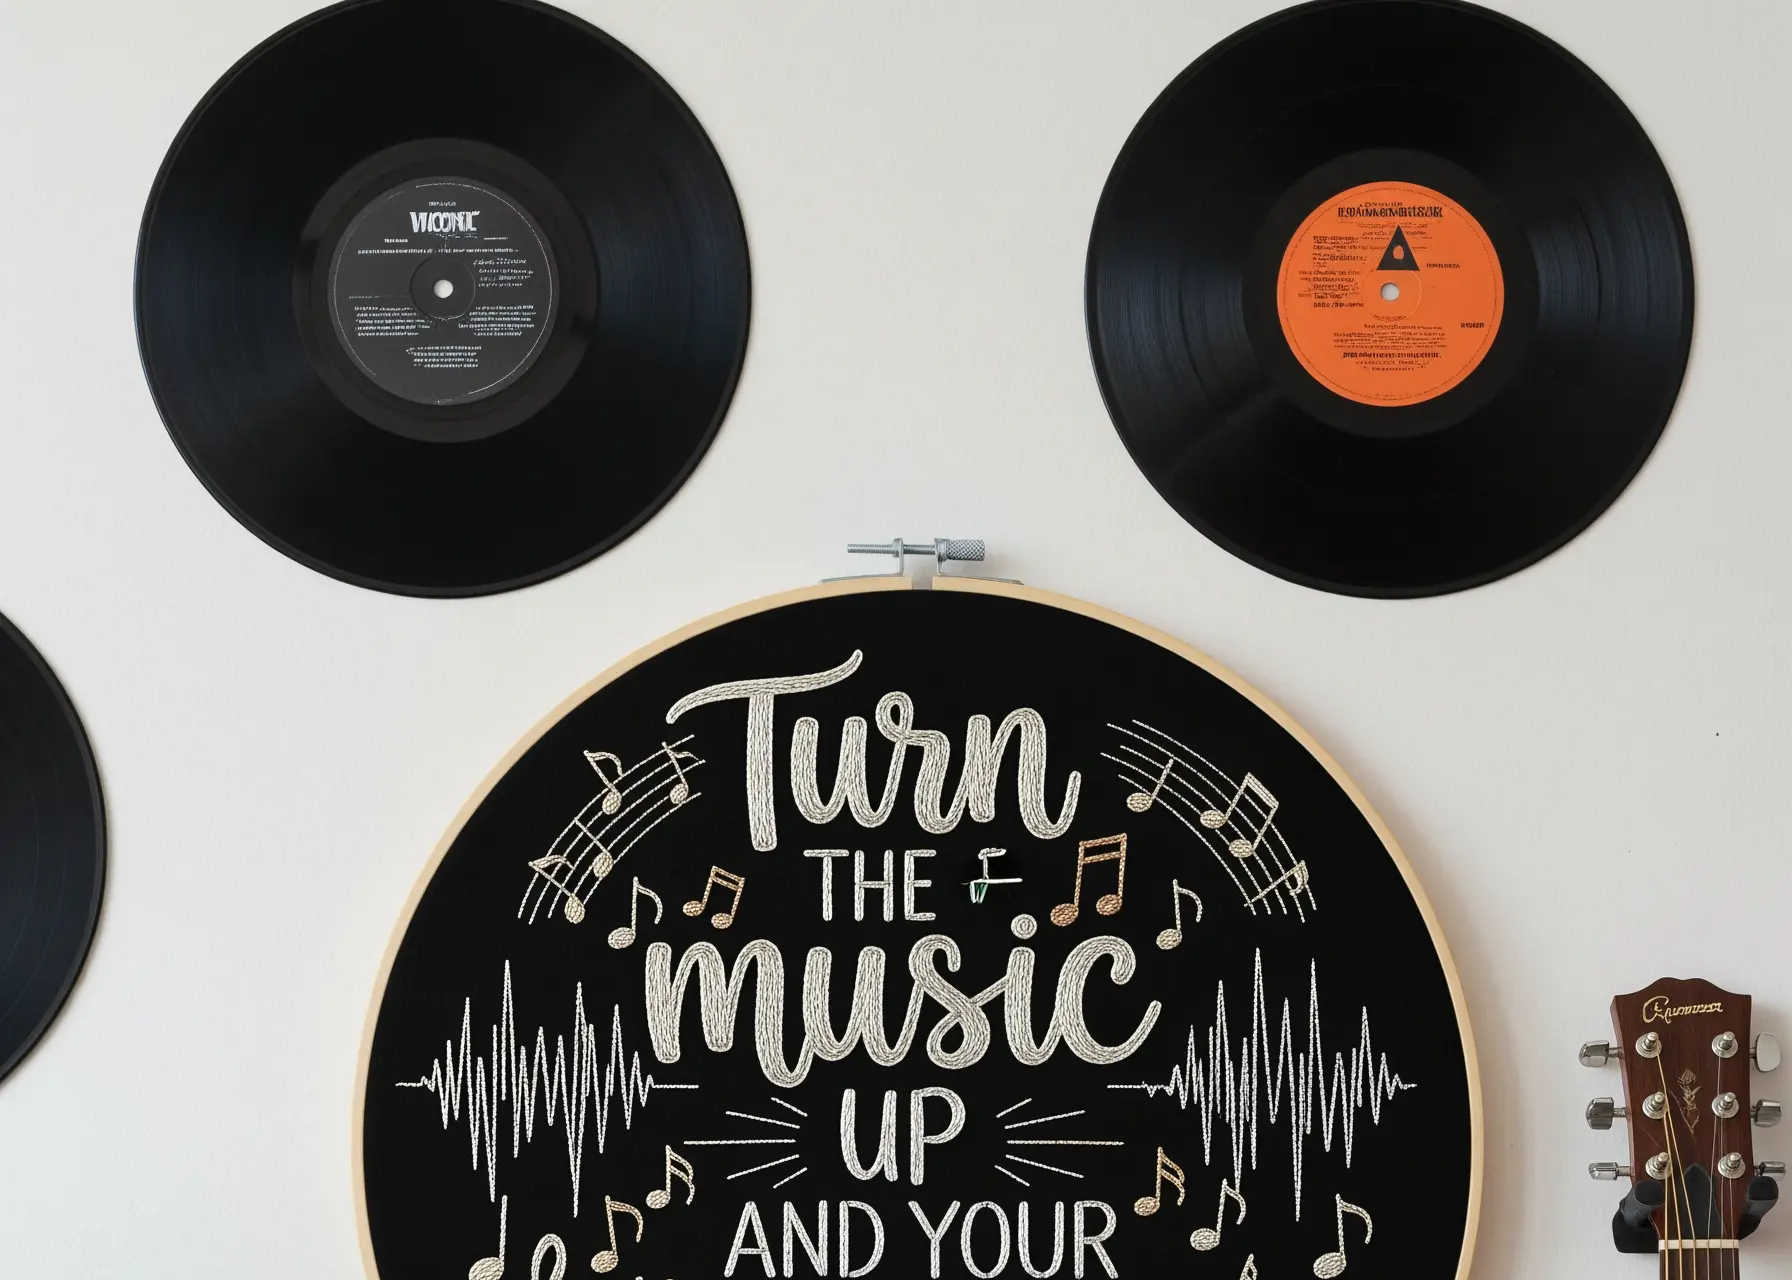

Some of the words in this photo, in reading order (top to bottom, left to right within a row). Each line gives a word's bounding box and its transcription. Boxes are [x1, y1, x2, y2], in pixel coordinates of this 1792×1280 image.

[666, 650, 1081, 851] Turn
[804, 850, 936, 921] THE
[645, 914, 1162, 1088] music
[840, 1087, 966, 1185] UP
[724, 1200, 885, 1278] AND
[908, 1200, 1119, 1279] YOUR
